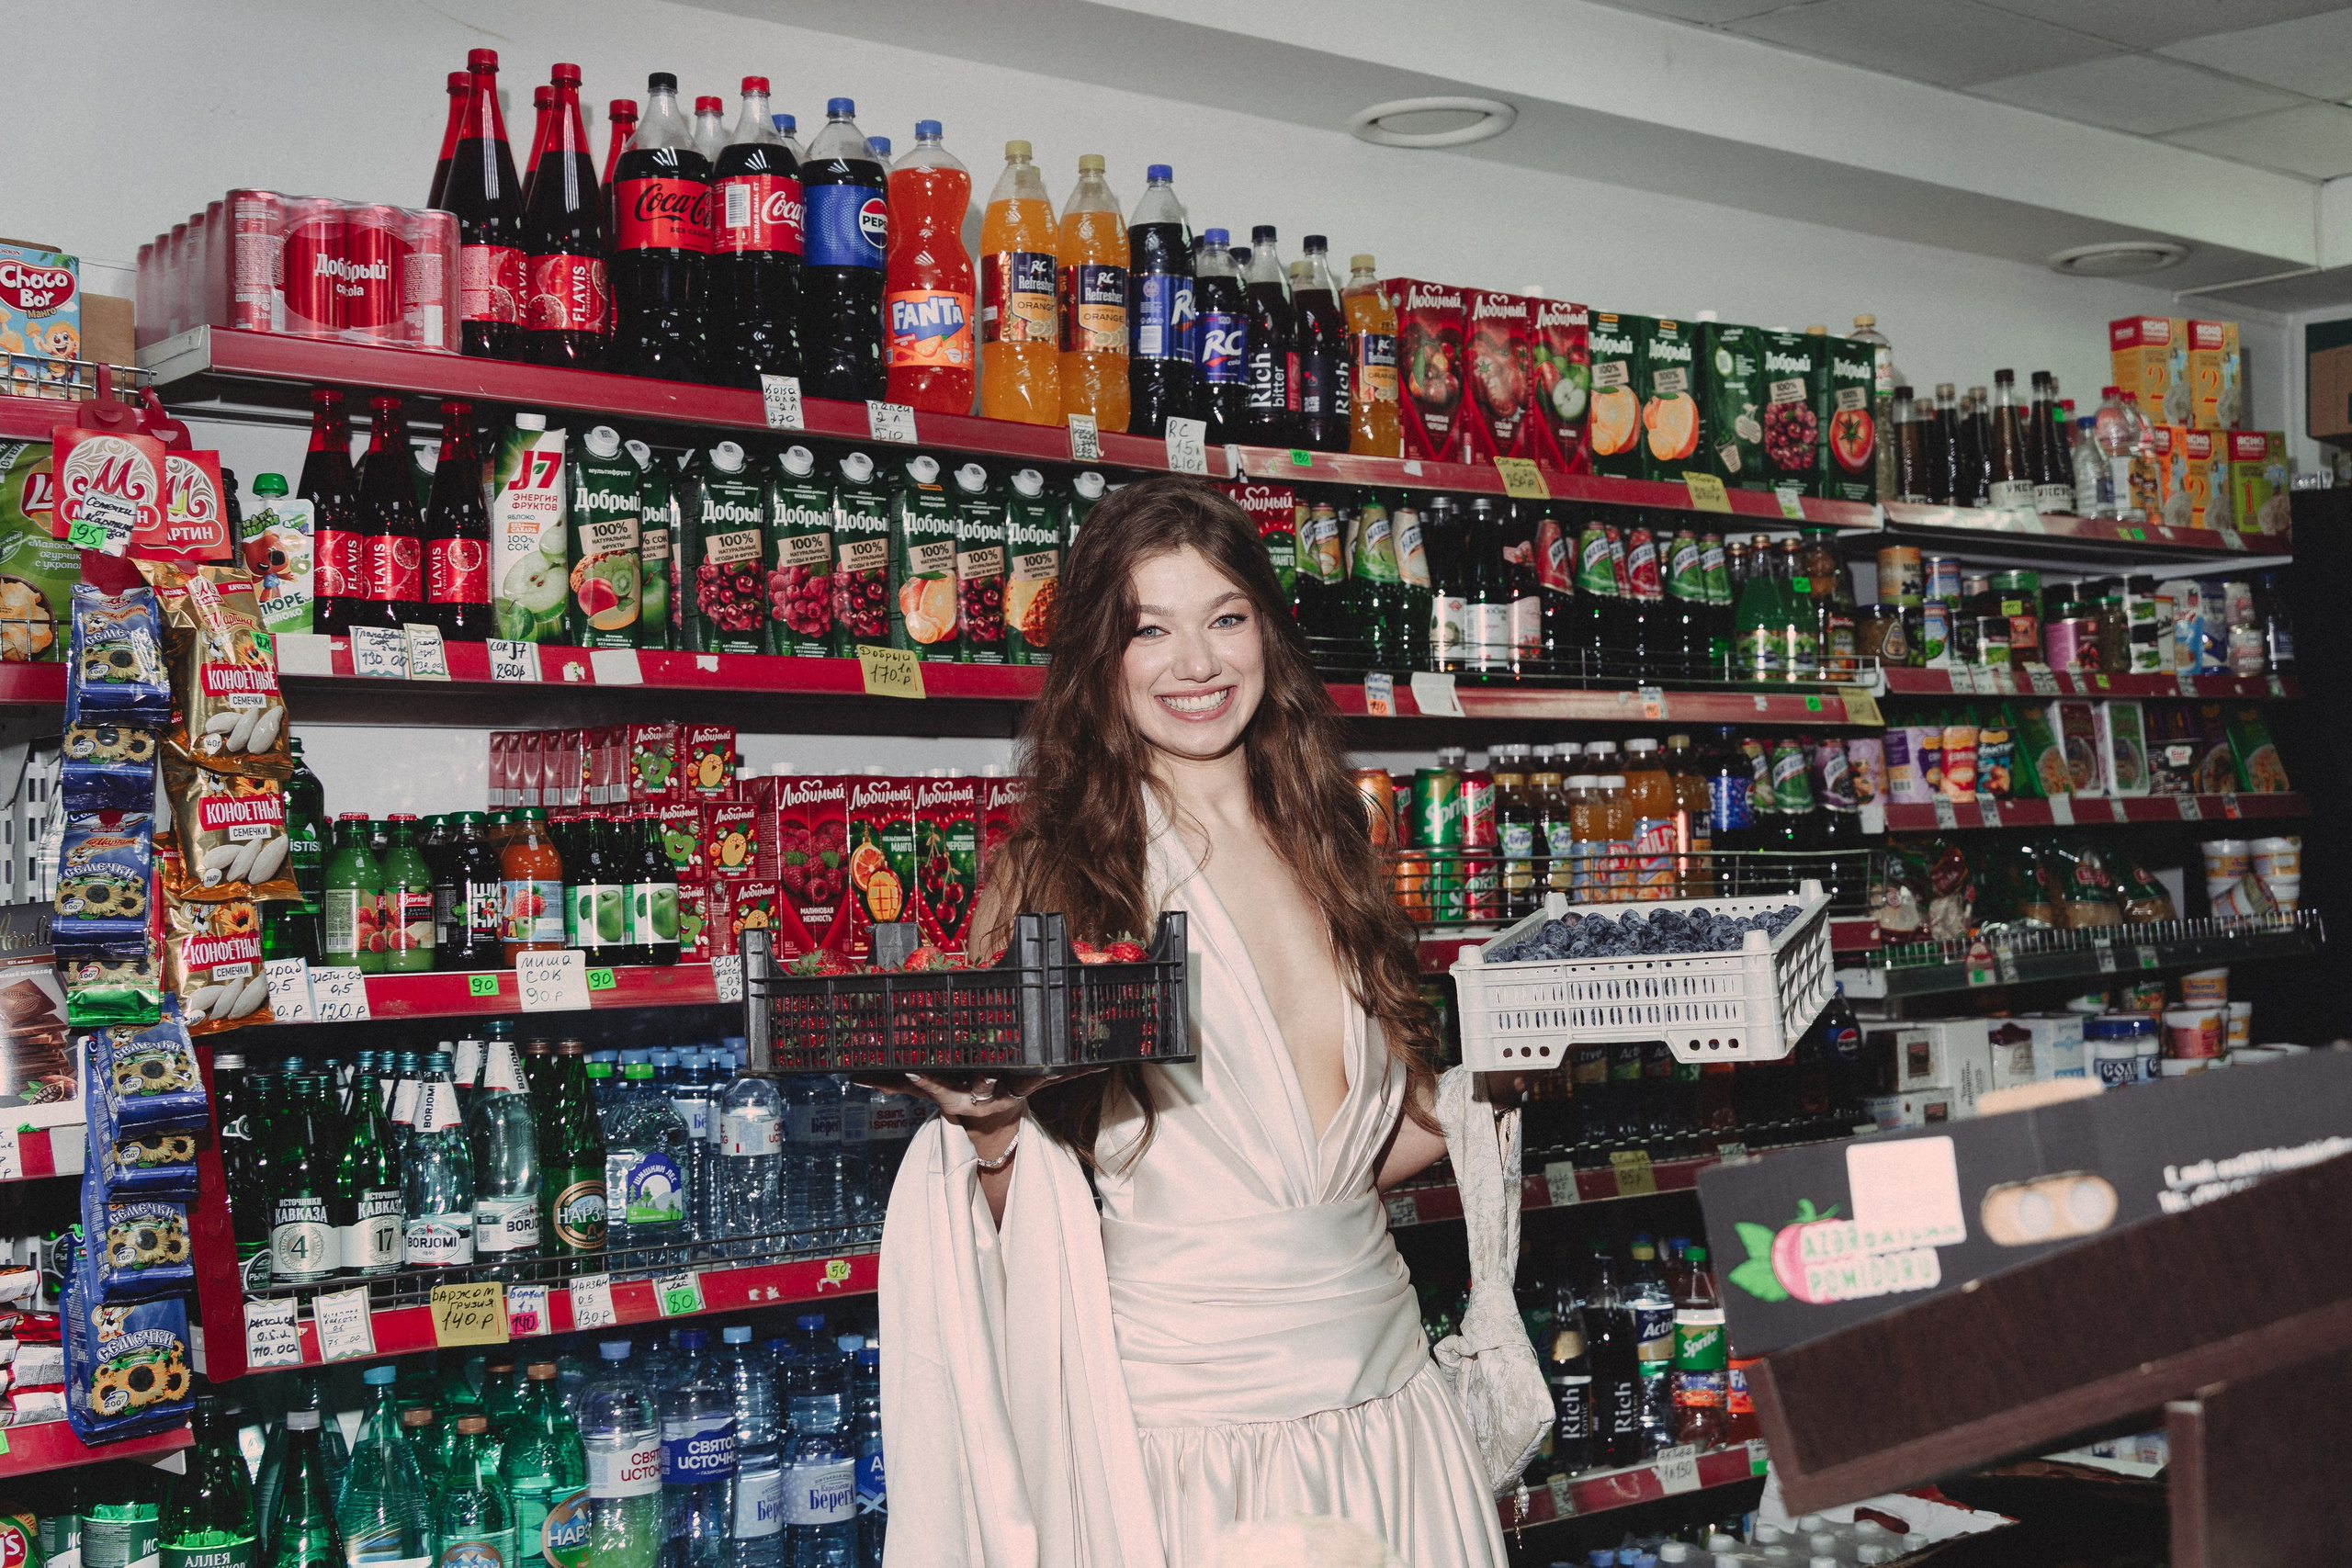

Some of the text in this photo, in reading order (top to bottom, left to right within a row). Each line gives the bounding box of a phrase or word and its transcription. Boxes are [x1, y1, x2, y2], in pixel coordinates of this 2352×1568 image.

[0, 265, 68, 289] Choco
[1018, 276, 1055, 292] Refresher
[572, 265, 586, 322] FLAVIS
[1084, 288, 1124, 304] Refresher
[1406, 285, 1461, 310] Любимый
[893, 299, 964, 330] FANTA
[1083, 312, 1125, 322] ORANGE
[1472, 294, 1527, 321] Любимый
[1535, 303, 1589, 329] Любимый
[1203, 330, 1243, 360] RC
[1649, 339, 1691, 361] Добрый
[1765, 351, 1811, 373] Добрый
[1250, 352, 1272, 408] Rich
[1272, 367, 1285, 408] bitter
[1335, 361, 1350, 414] Rich
[1169, 420, 1188, 438] RC
[508, 450, 562, 491] J7
[512, 502, 558, 512] ФРУКТОВ
[513, 493, 558, 502] ЭНЕРГИЯ
[574, 487, 640, 513] Добрый
[1238, 486, 1293, 512] юбимый
[702, 501, 763, 525] Добрый
[774, 503, 831, 527] Добрый
[834, 510, 889, 533] Добрый
[592, 523, 628, 536] 100%
[904, 513, 956, 536] Добрый
[507, 535, 535, 544] 100%
[592, 534, 632, 545] НАТУРАЛЬНЫЕ
[718, 533, 754, 547] 100%
[791, 536, 823, 549] 100%
[1008, 524, 1059, 545] Добрый
[507, 543, 530, 551] СОК
[718, 545, 756, 555] НАТУРАЛЬНЫЕ
[790, 548, 825, 557] НАТУРАЛЬНЫЕ
[852, 542, 883, 555] 100%
[921, 545, 949, 558] 100%
[968, 550, 998, 563] 100%
[348, 539, 357, 591] FLAVIS
[374, 543, 385, 593] FLAVIS
[1023, 554, 1052, 567] 100%
[433, 547, 442, 596] FLAVIS
[209, 670, 277, 691] КОНФЕТНЫЕ
[233, 695, 264, 705] СЕМЕЧКИ
[691, 728, 731, 744] Любимый
[779, 780, 845, 810] Любимый
[849, 781, 911, 810] Любимый
[915, 782, 974, 810] Любимый
[207, 801, 282, 824] КОНФЕТНЫЕ
[660, 805, 698, 820] Любимый
[715, 807, 754, 824] Любимый
[233, 827, 268, 838] СЕМЕЧКИ
[890, 841, 912, 852] МАНГО
[946, 841, 975, 851] ЧЕРЕШНЯ
[64, 863, 136, 882] СЕМЕЧКИ
[737, 883, 775, 902] Любимый
[800, 907, 833, 915] МАЛИНОВАЯ
[803, 915, 832, 923] НЕЖНОСТЬ
[191, 937, 261, 964] КОНФЕТНЫЕ
[217, 965, 249, 978] СЕМЕЧКИ
[591, 973, 611, 987] 90
[331, 983, 353, 997] 0,5
[472, 978, 493, 993] 90
[113, 1041, 182, 1061] СЕМЕЧКИ
[508, 1044, 525, 1090] BORJOMI
[424, 1085, 435, 1129] BORJOMI
[633, 1164, 678, 1187] ШИШКИН ЛЕС
[279, 1197, 322, 1207] ИСТОЧНИКИ
[108, 1202, 178, 1224] СЕМЕЧКИ
[275, 1205, 327, 1224] КАВКАЗА
[557, 1206, 606, 1224] НАРЗА
[290, 1235, 309, 1259] 4
[376, 1228, 394, 1252] 17
[408, 1235, 458, 1248] BORJOMI
[830, 1264, 847, 1278] 50
[669, 1293, 692, 1312] 80
[96, 1329, 175, 1363] СЕМЕЧКИ
[1683, 1331, 1718, 1359] Sprite
[124, 1357, 155, 1368] отборные
[105, 1399, 125, 1408] 200г
[1563, 1385, 1579, 1438] Rich
[1614, 1382, 1631, 1433] Rich
[185, 1552, 231, 1567] АЛЛЕЯ
